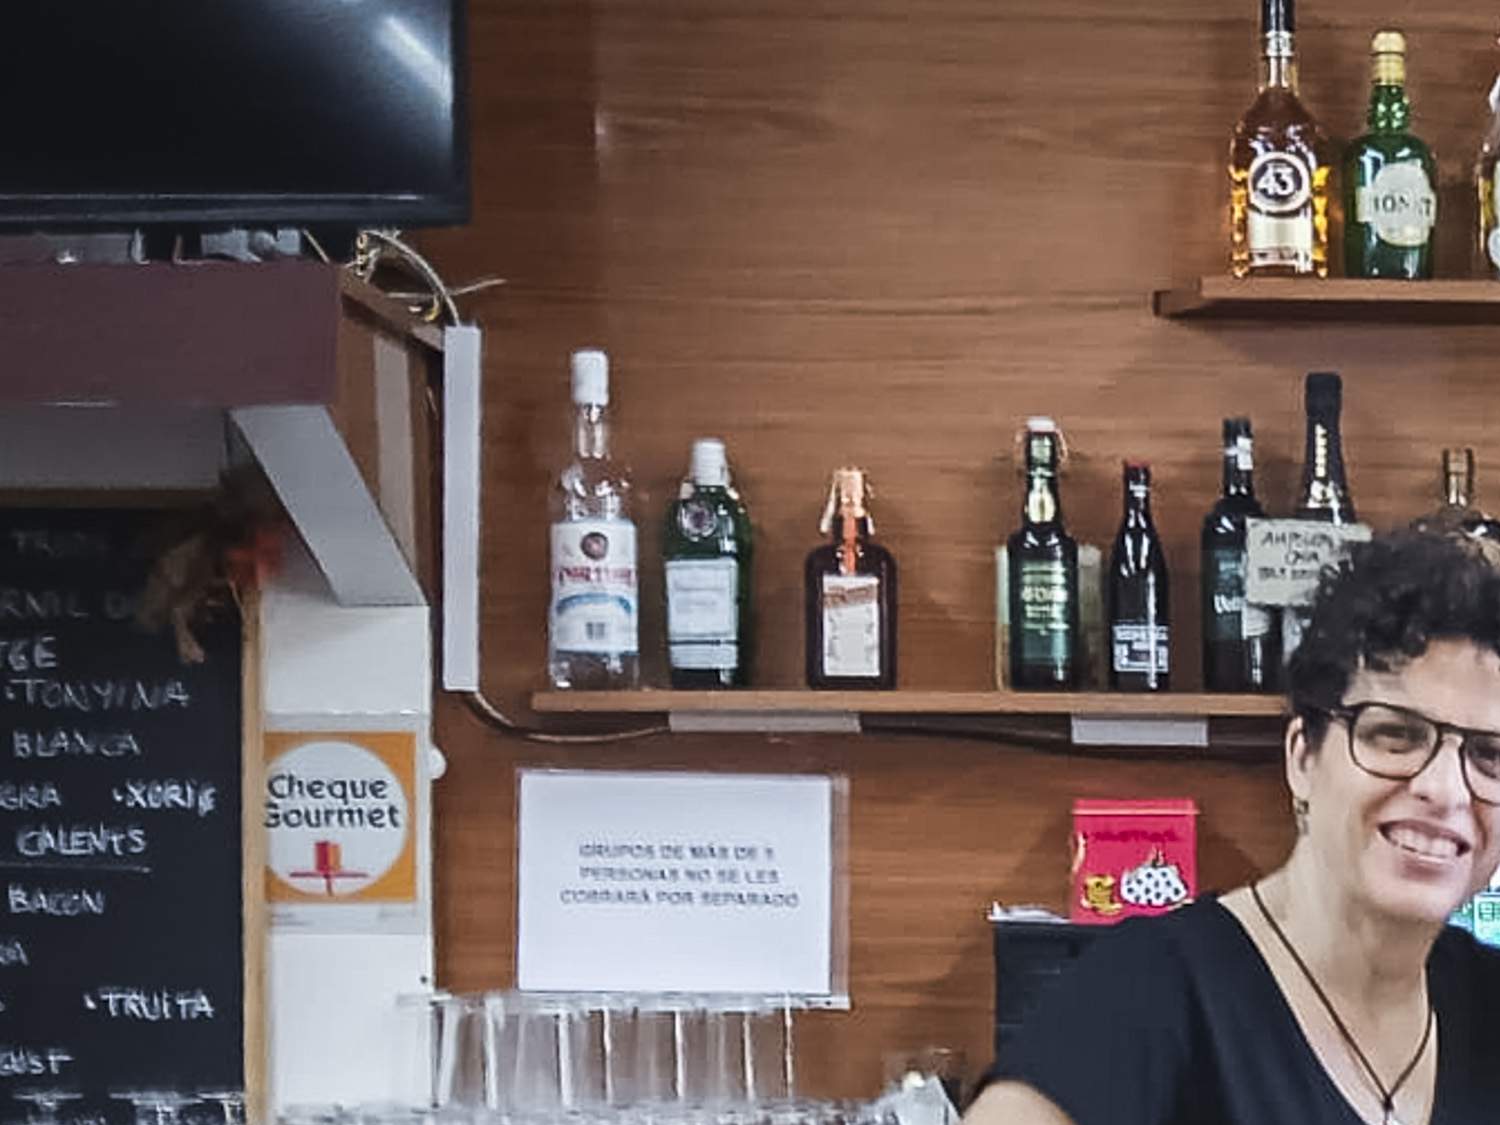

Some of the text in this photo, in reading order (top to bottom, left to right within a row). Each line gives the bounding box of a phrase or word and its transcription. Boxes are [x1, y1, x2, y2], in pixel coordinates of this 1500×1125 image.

[1257, 163, 1295, 196] 43
[268, 773, 387, 805] Cheque
[264, 801, 400, 828] Gourmet
[579, 844, 655, 859] GRUPOS
[580, 867, 680, 883] PERSONAS
